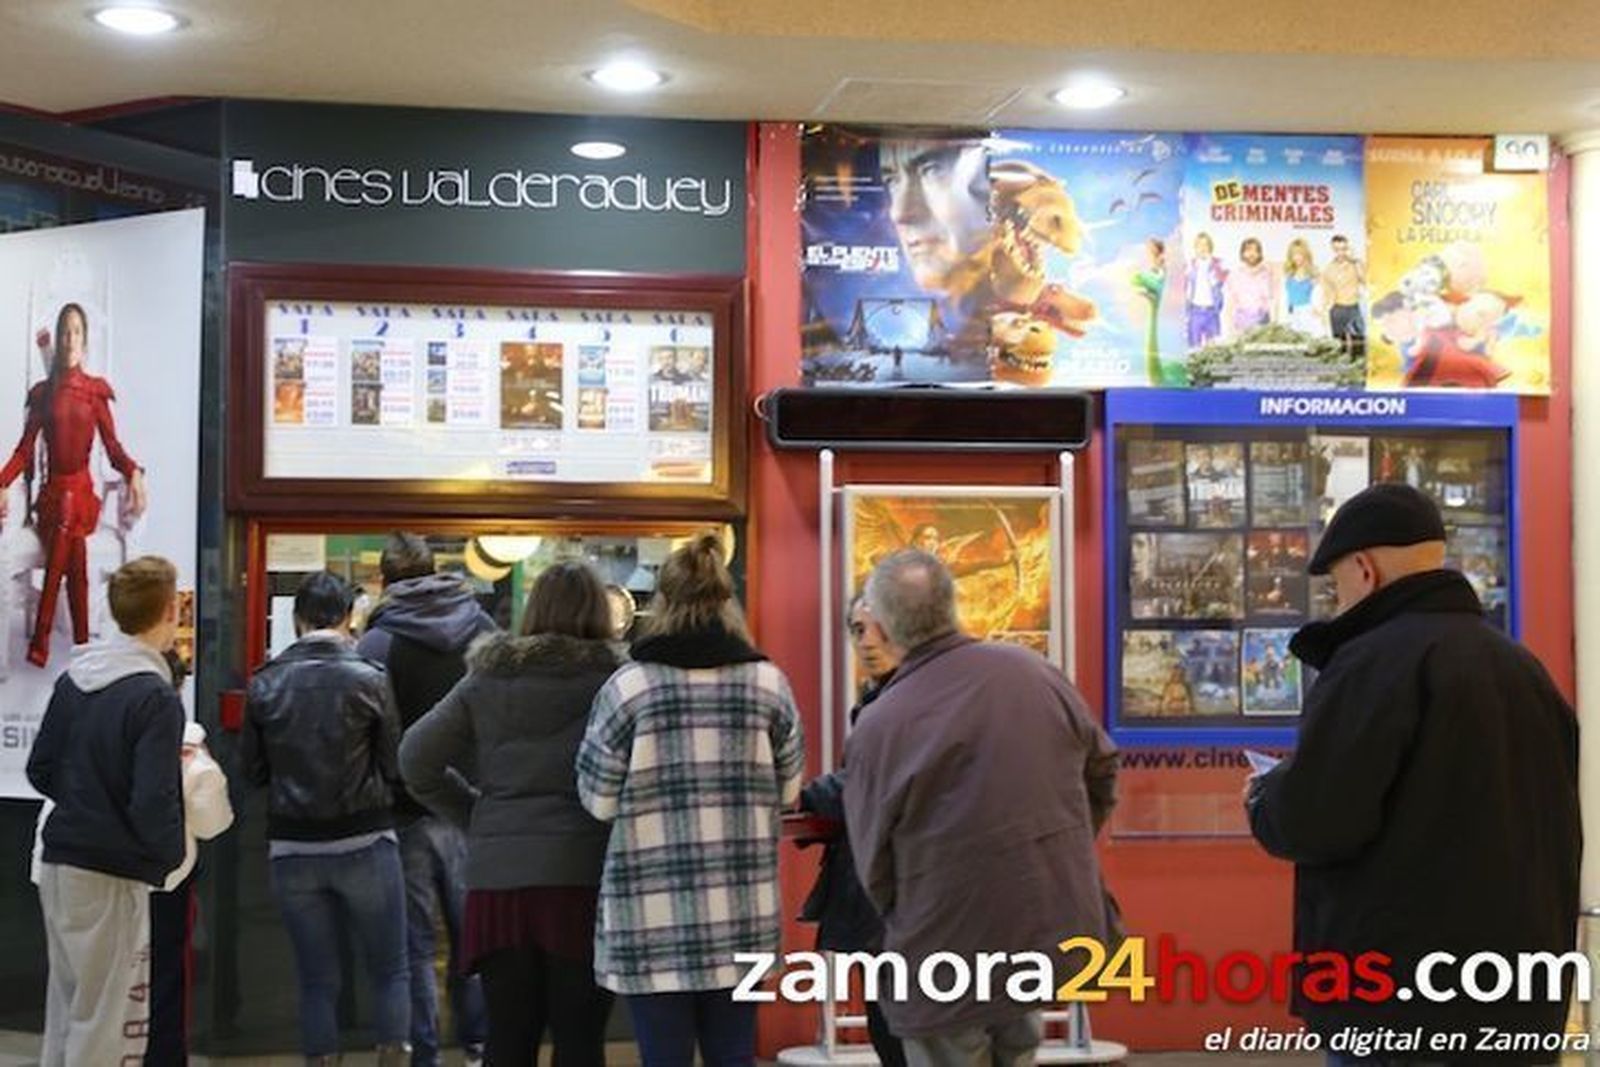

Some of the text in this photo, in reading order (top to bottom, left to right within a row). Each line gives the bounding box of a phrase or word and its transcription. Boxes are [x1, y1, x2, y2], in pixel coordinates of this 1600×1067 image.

[1213, 181, 1330, 204] DE MENTES
[1210, 204, 1335, 223] CRIMINALES
